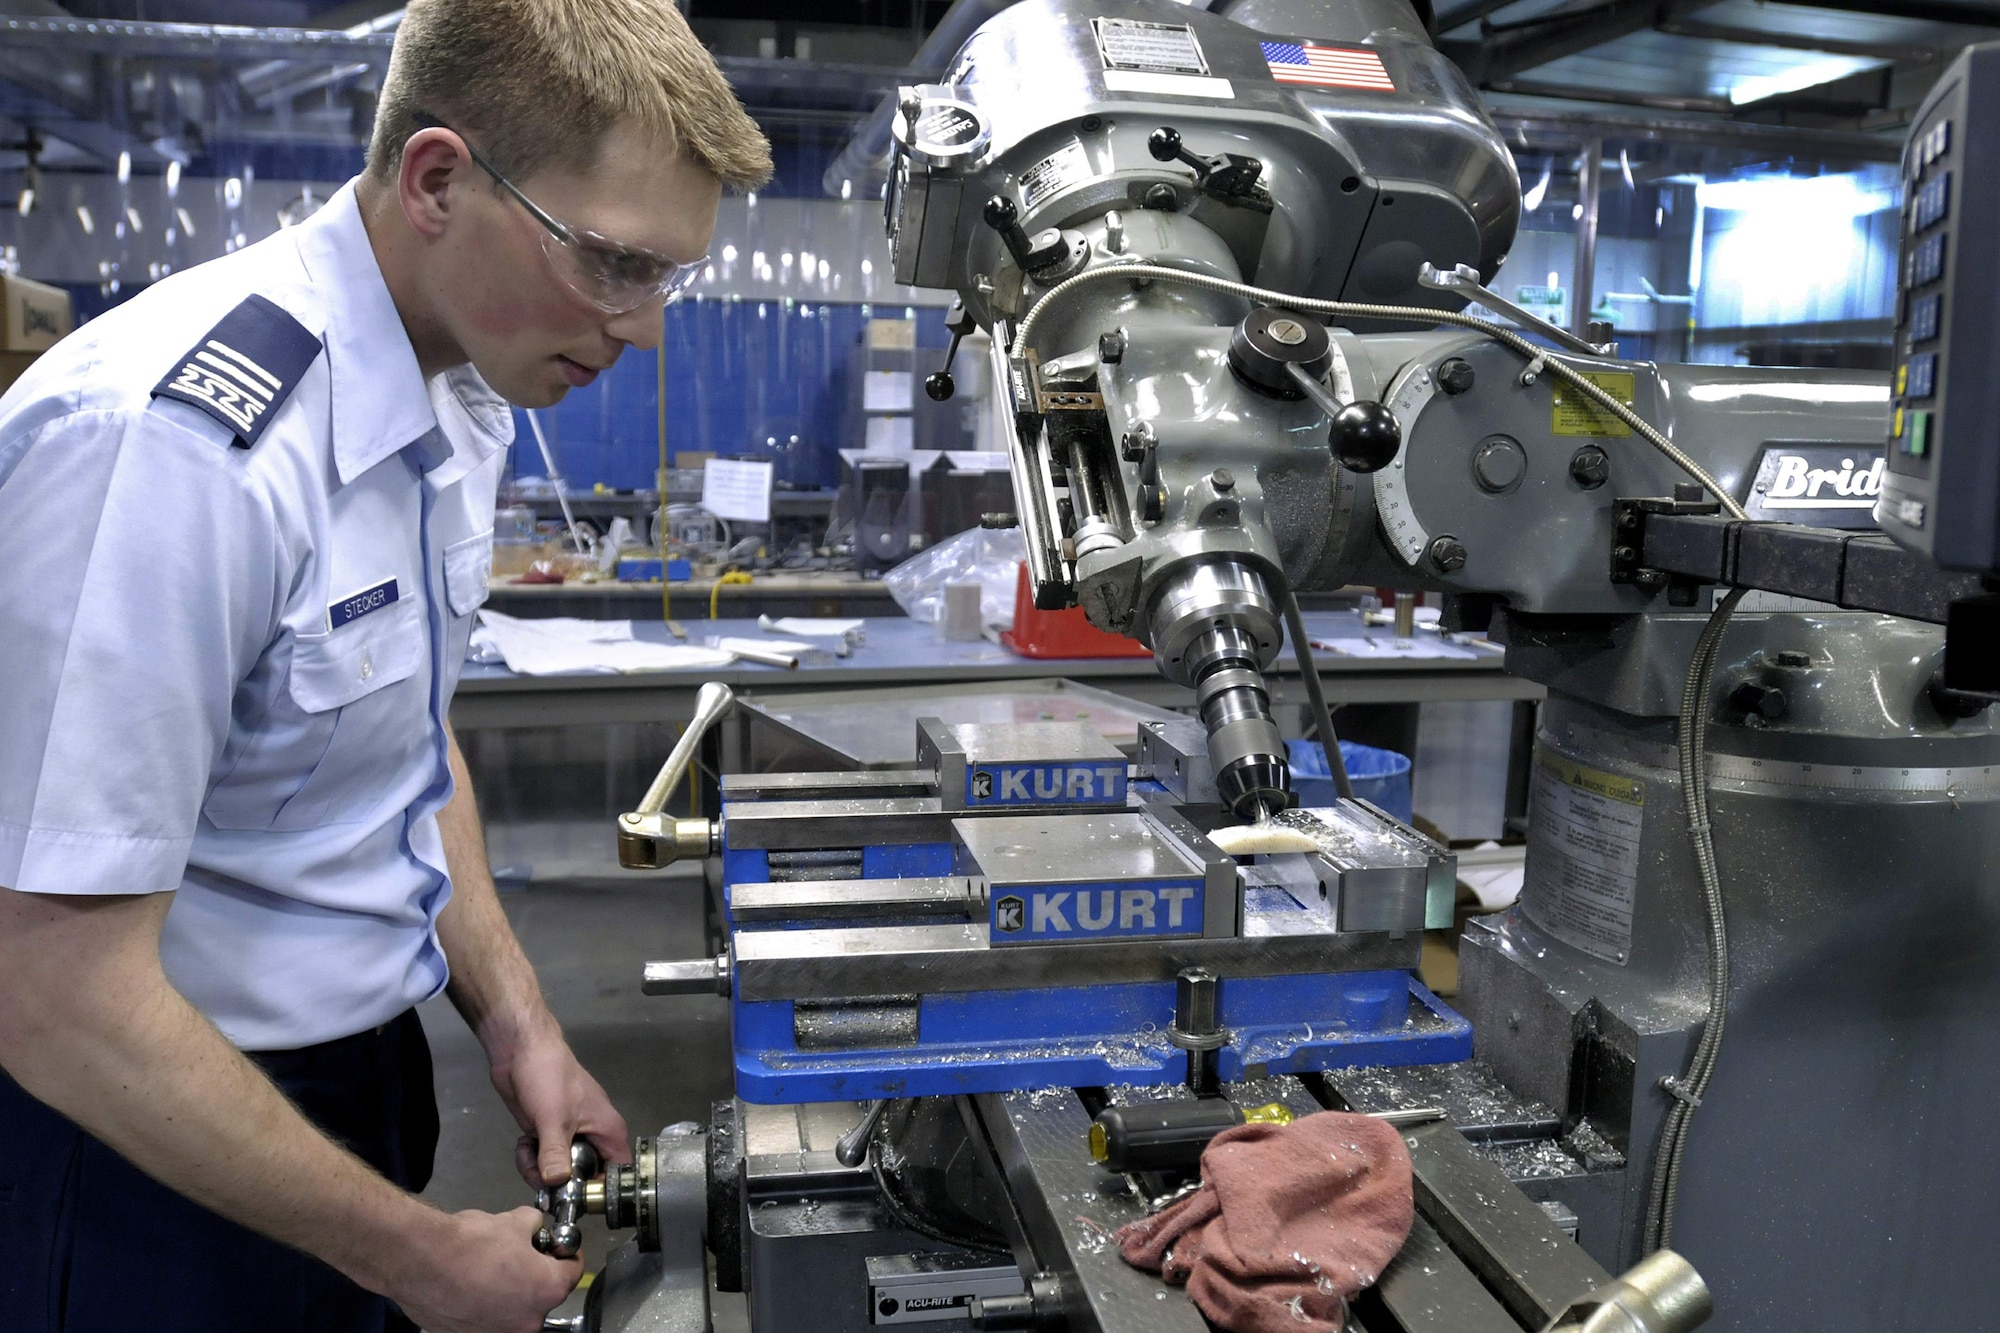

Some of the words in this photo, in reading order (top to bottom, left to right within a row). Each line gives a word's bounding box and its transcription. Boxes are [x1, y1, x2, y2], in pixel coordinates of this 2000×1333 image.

[1766, 456, 1885, 510] Brid
[1408, 536, 1417, 545] 40
[344, 589, 386, 619] STECKER
[1001, 767, 1124, 800] KURT
[1583, 779, 1606, 793] MUCHO
[999, 902, 1021, 910] KURT
[1032, 887, 1195, 933] KURT
[907, 1296, 954, 1309] ACU-RITE
